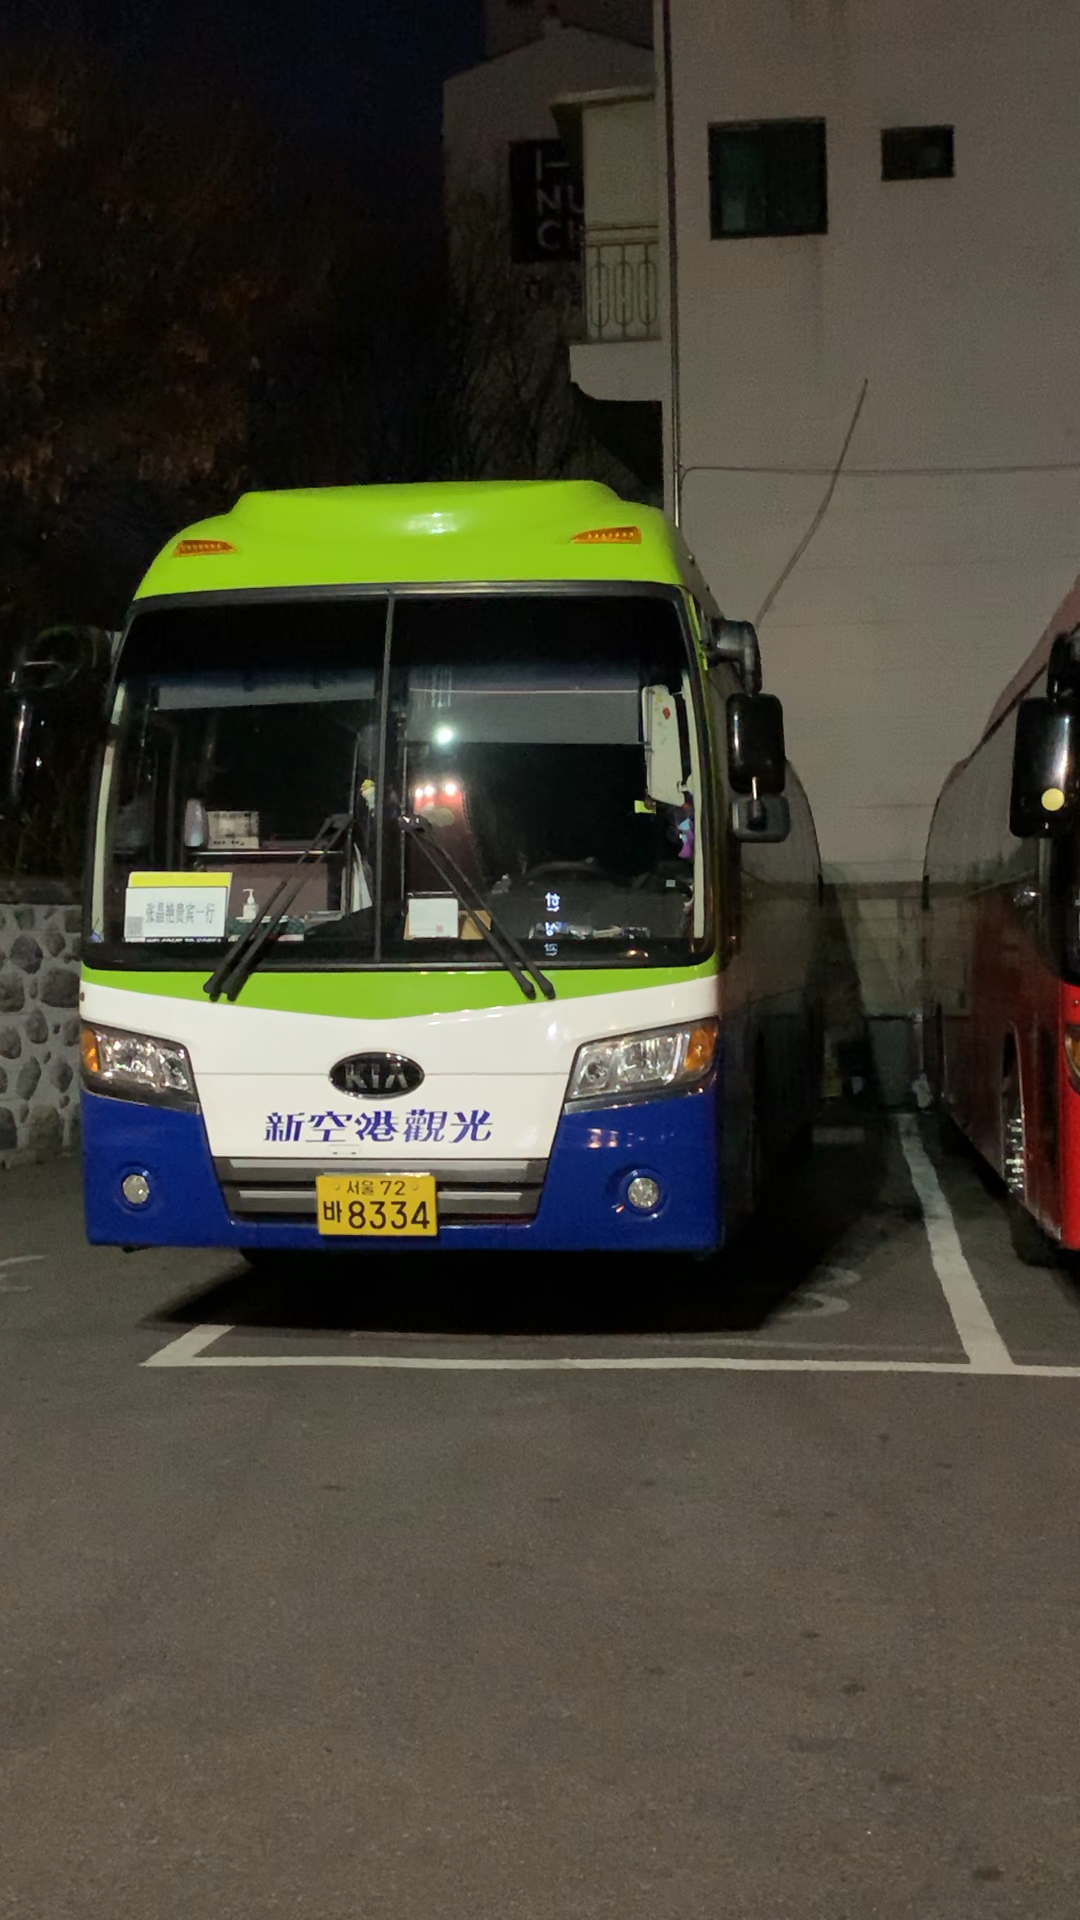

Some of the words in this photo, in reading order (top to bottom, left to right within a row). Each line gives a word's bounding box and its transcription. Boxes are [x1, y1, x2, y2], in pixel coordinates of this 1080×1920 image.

[345, 1063, 408, 1089] KIA
[263, 1109, 493, 1144] 新空港觀光
[346, 1180, 375, 1197] 서울
[380, 1180, 406, 1197] 72
